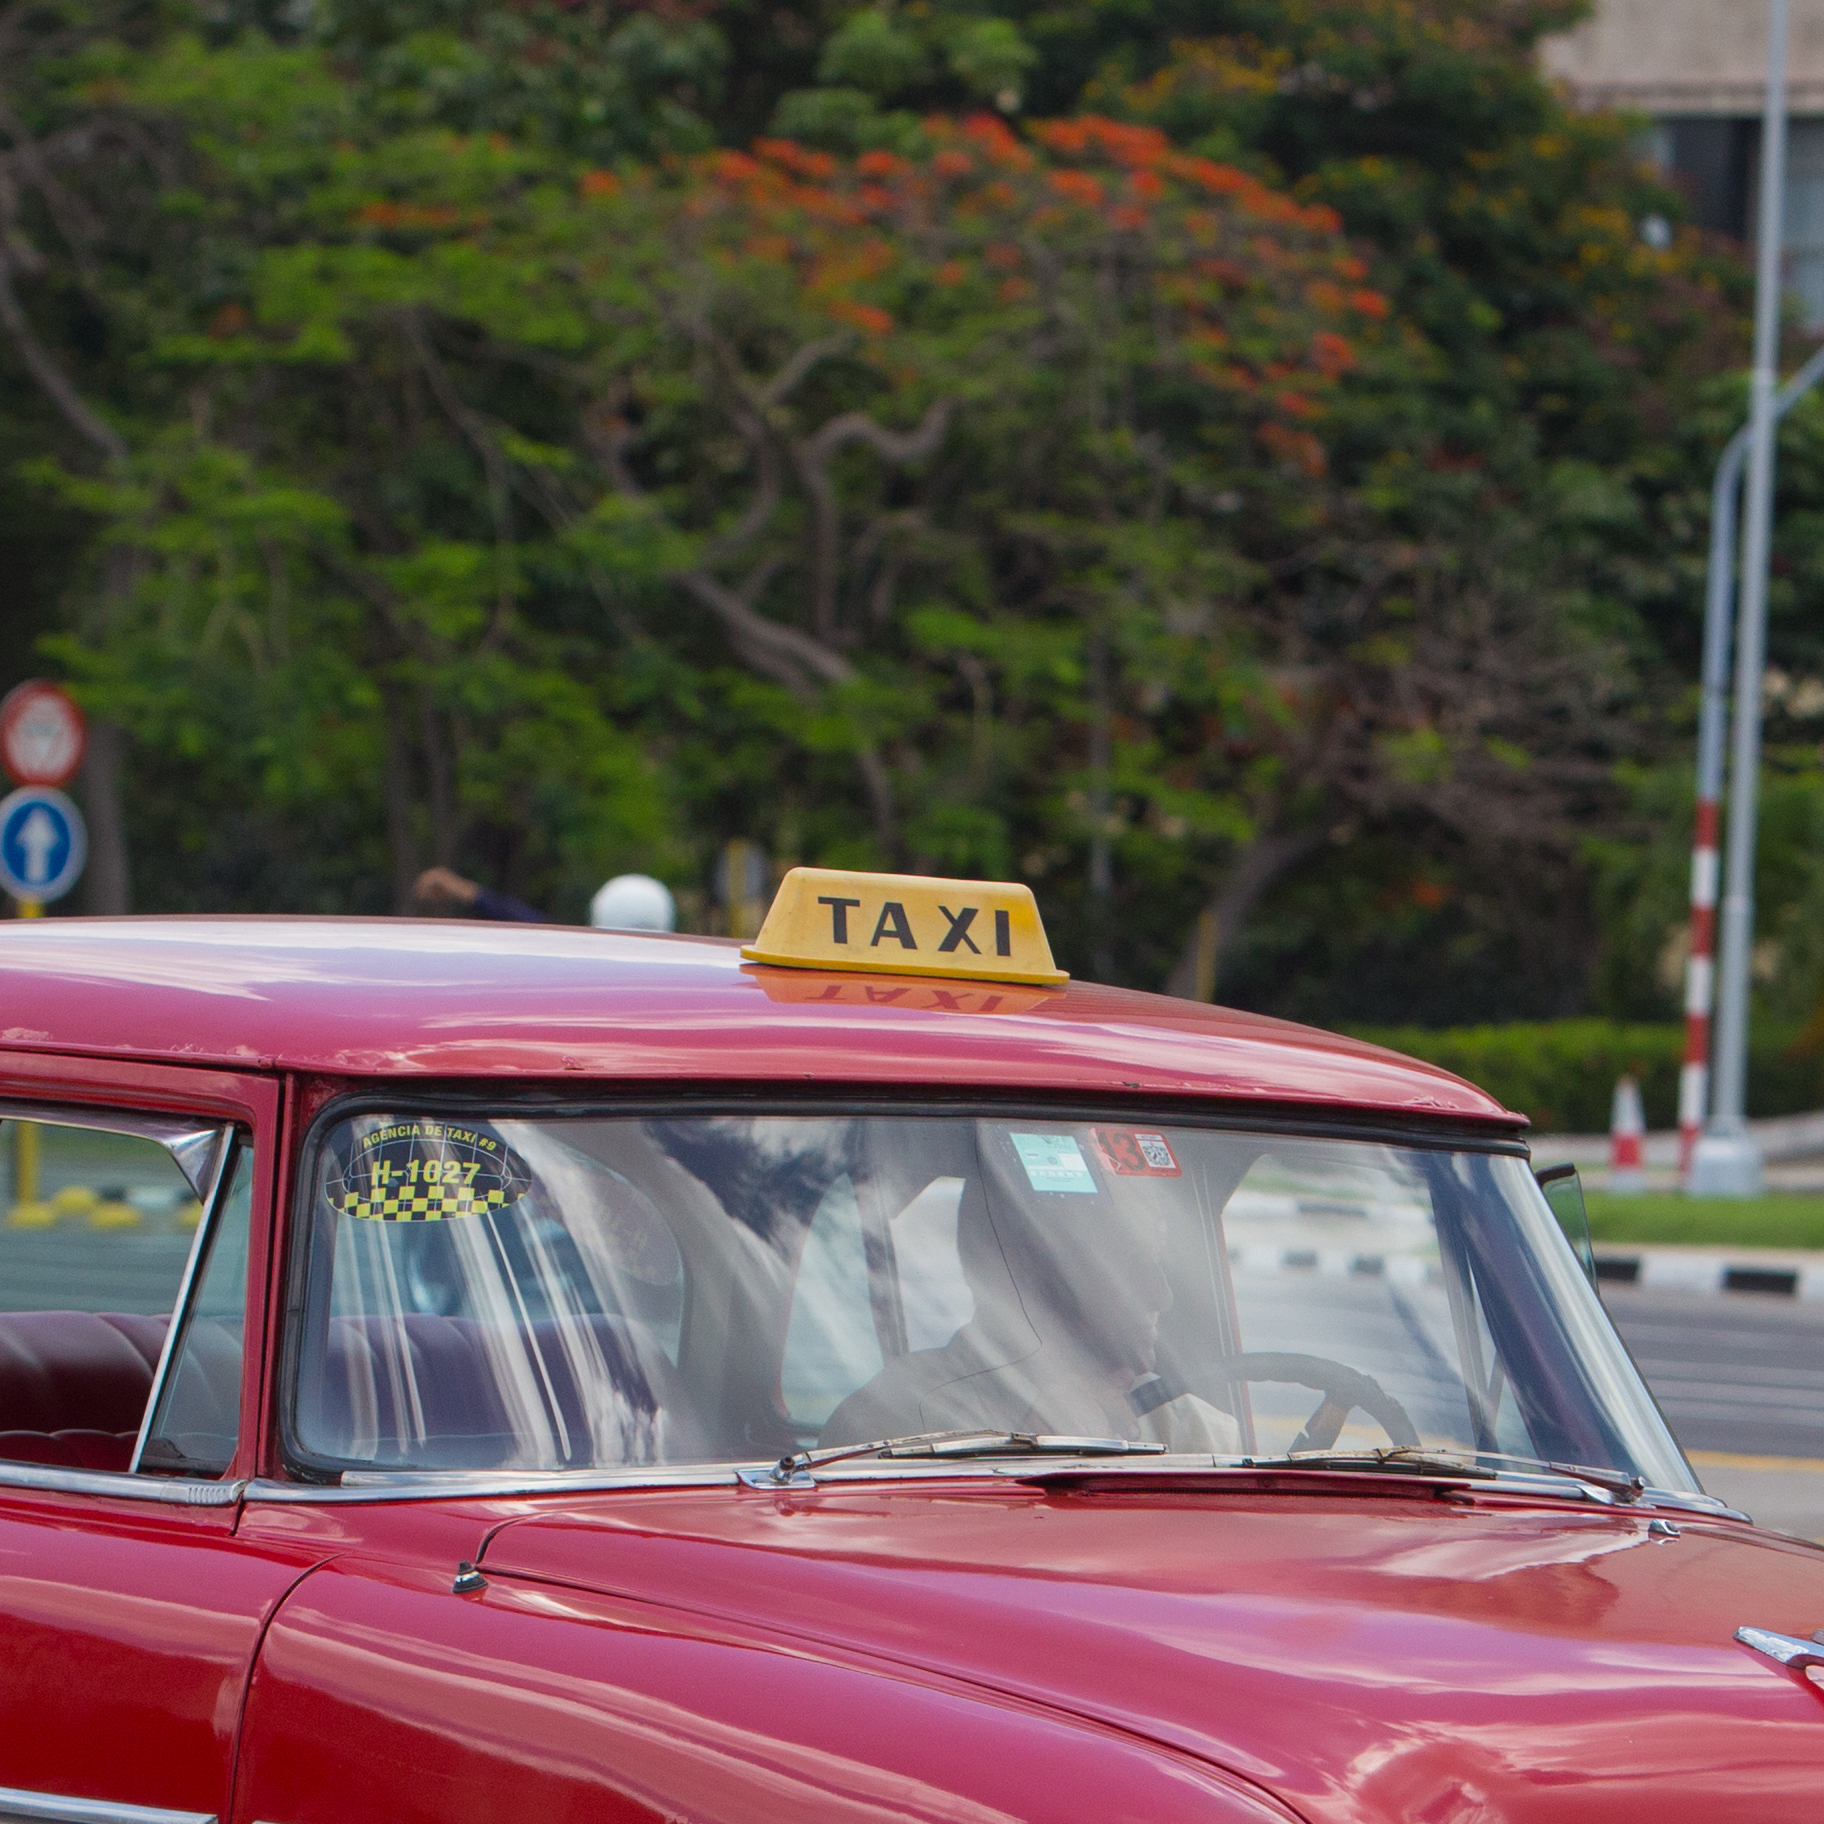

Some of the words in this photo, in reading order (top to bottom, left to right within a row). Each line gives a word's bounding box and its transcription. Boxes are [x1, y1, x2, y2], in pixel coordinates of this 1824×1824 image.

[818, 896, 1011, 957] TAXI
[362, 1125, 421, 1149] AGENCIA
[425, 1125, 442, 1136] DE
[447, 1127, 477, 1143] TAXI
[479, 1138, 497, 1151] #9
[1098, 1131, 1146, 1171] 13
[371, 1160, 481, 1186] H-1027
